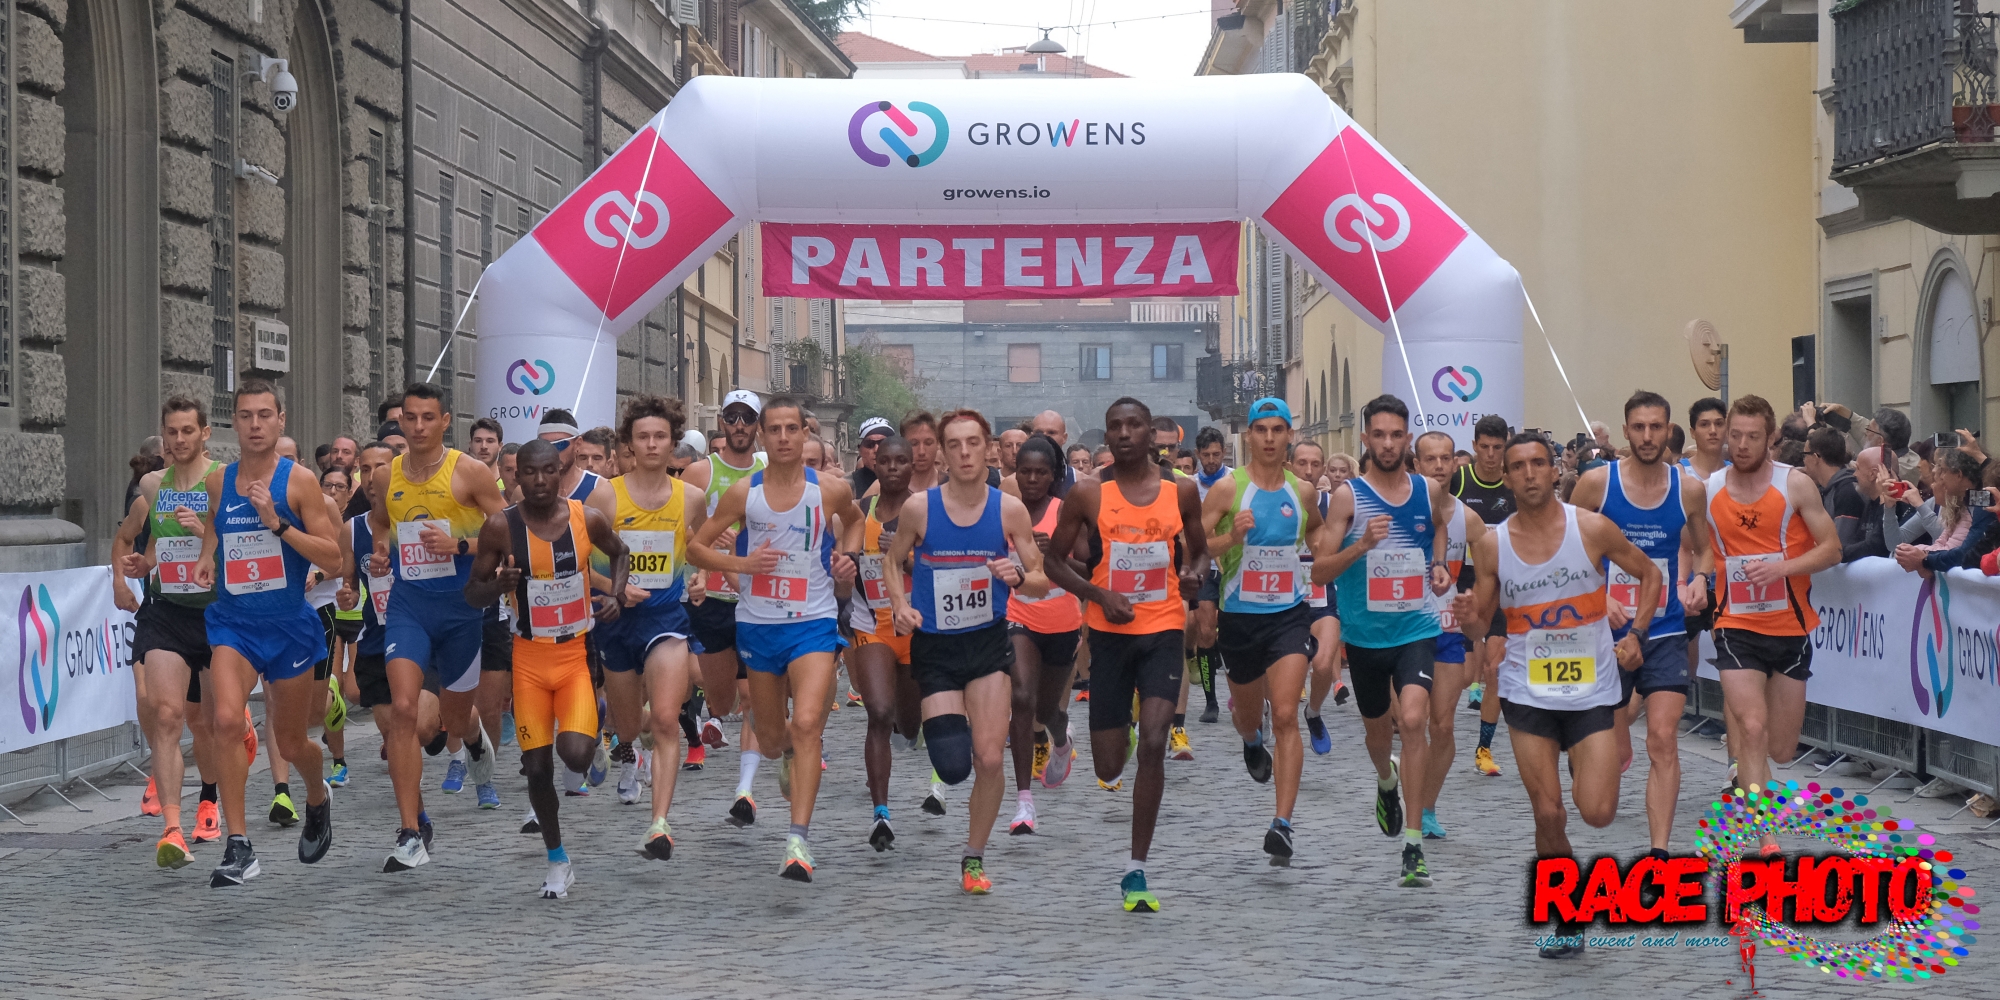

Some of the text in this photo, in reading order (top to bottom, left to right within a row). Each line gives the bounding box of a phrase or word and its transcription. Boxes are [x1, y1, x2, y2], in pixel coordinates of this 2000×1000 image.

[967, 118, 1146, 148] GROWENS
[942, 185, 1051, 201] growens.io
[791, 235, 1213, 287] PARTENZA
[489, 404, 573, 420] GROWE
[1414, 411, 1499, 427] GROWE
[158, 488, 208, 502] Vicenza
[156, 501, 208, 513] Marthon
[1621, 528, 1667, 539] Ermenegildo
[1631, 538, 1655, 547] Zegna
[176, 564, 188, 582] 9
[246, 561, 260, 581] 3
[768, 578, 791, 599] 16
[1134, 572, 1146, 591] 2
[1259, 573, 1280, 592] 12
[1392, 579, 1405, 599] 5
[1504, 567, 1590, 600] Green Bar
[942, 589, 987, 612] 3149
[1745, 583, 1767, 601] 17
[553, 606, 564, 625] 1
[1814, 602, 1885, 660] GROWENS
[1542, 661, 1583, 682] 125
